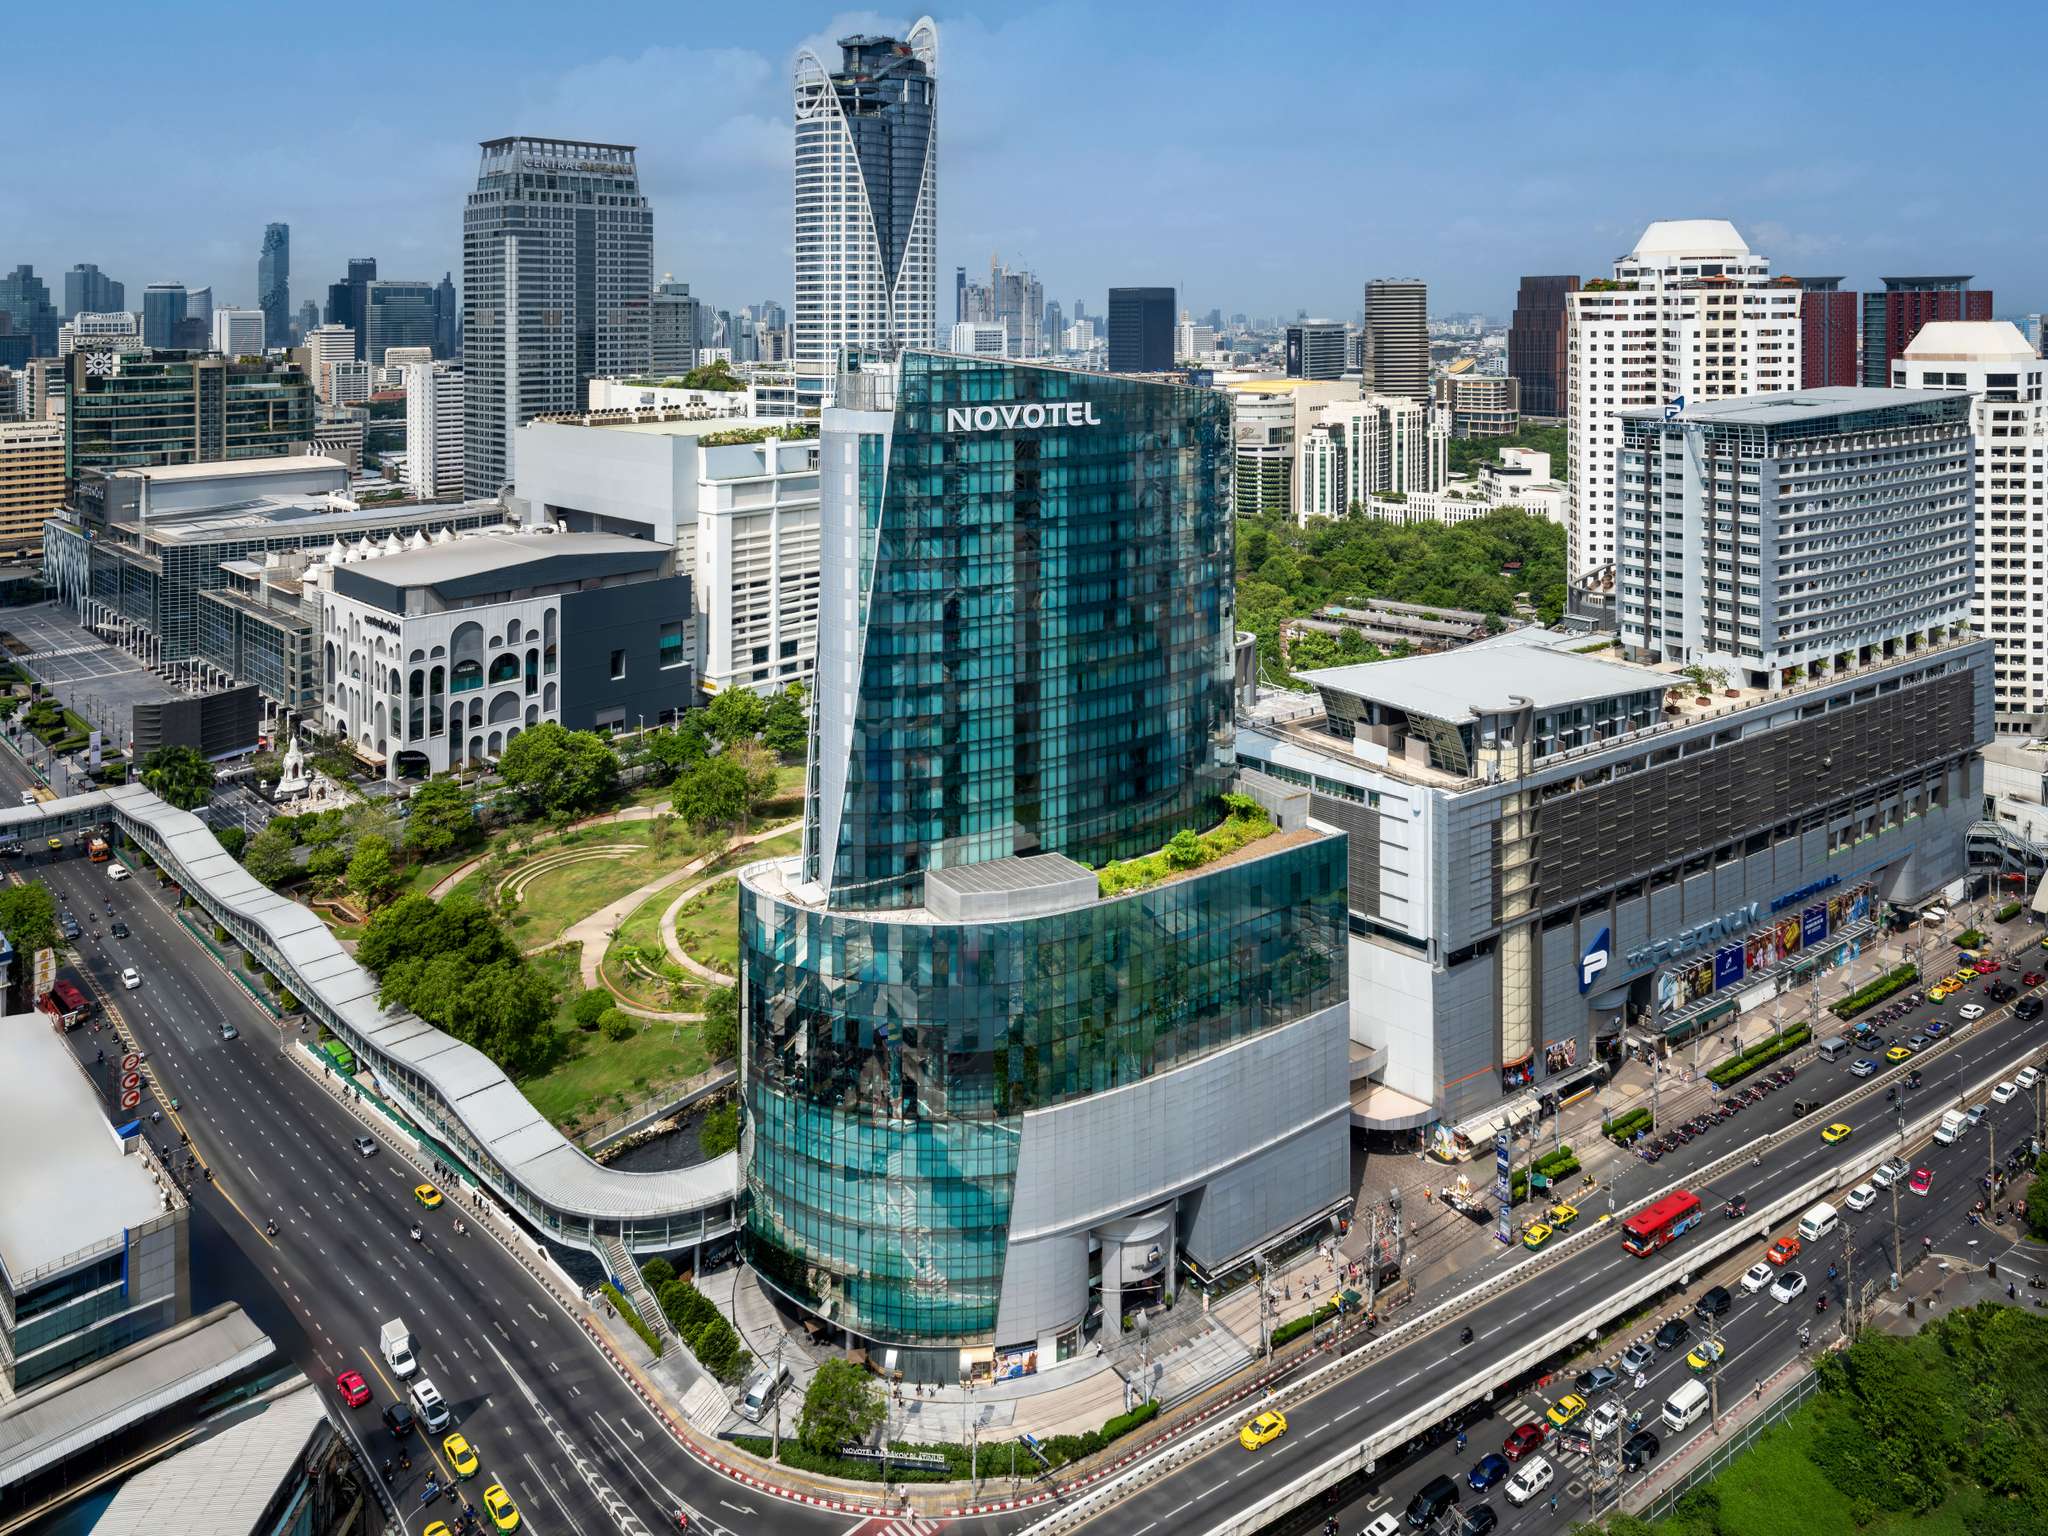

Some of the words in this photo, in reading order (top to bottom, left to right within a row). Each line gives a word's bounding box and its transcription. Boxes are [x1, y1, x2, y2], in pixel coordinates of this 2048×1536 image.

[948, 402, 1101, 432] NOVOTEL
[1583, 950, 1608, 985] P
[843, 1448, 873, 1456] NOVOTEL
